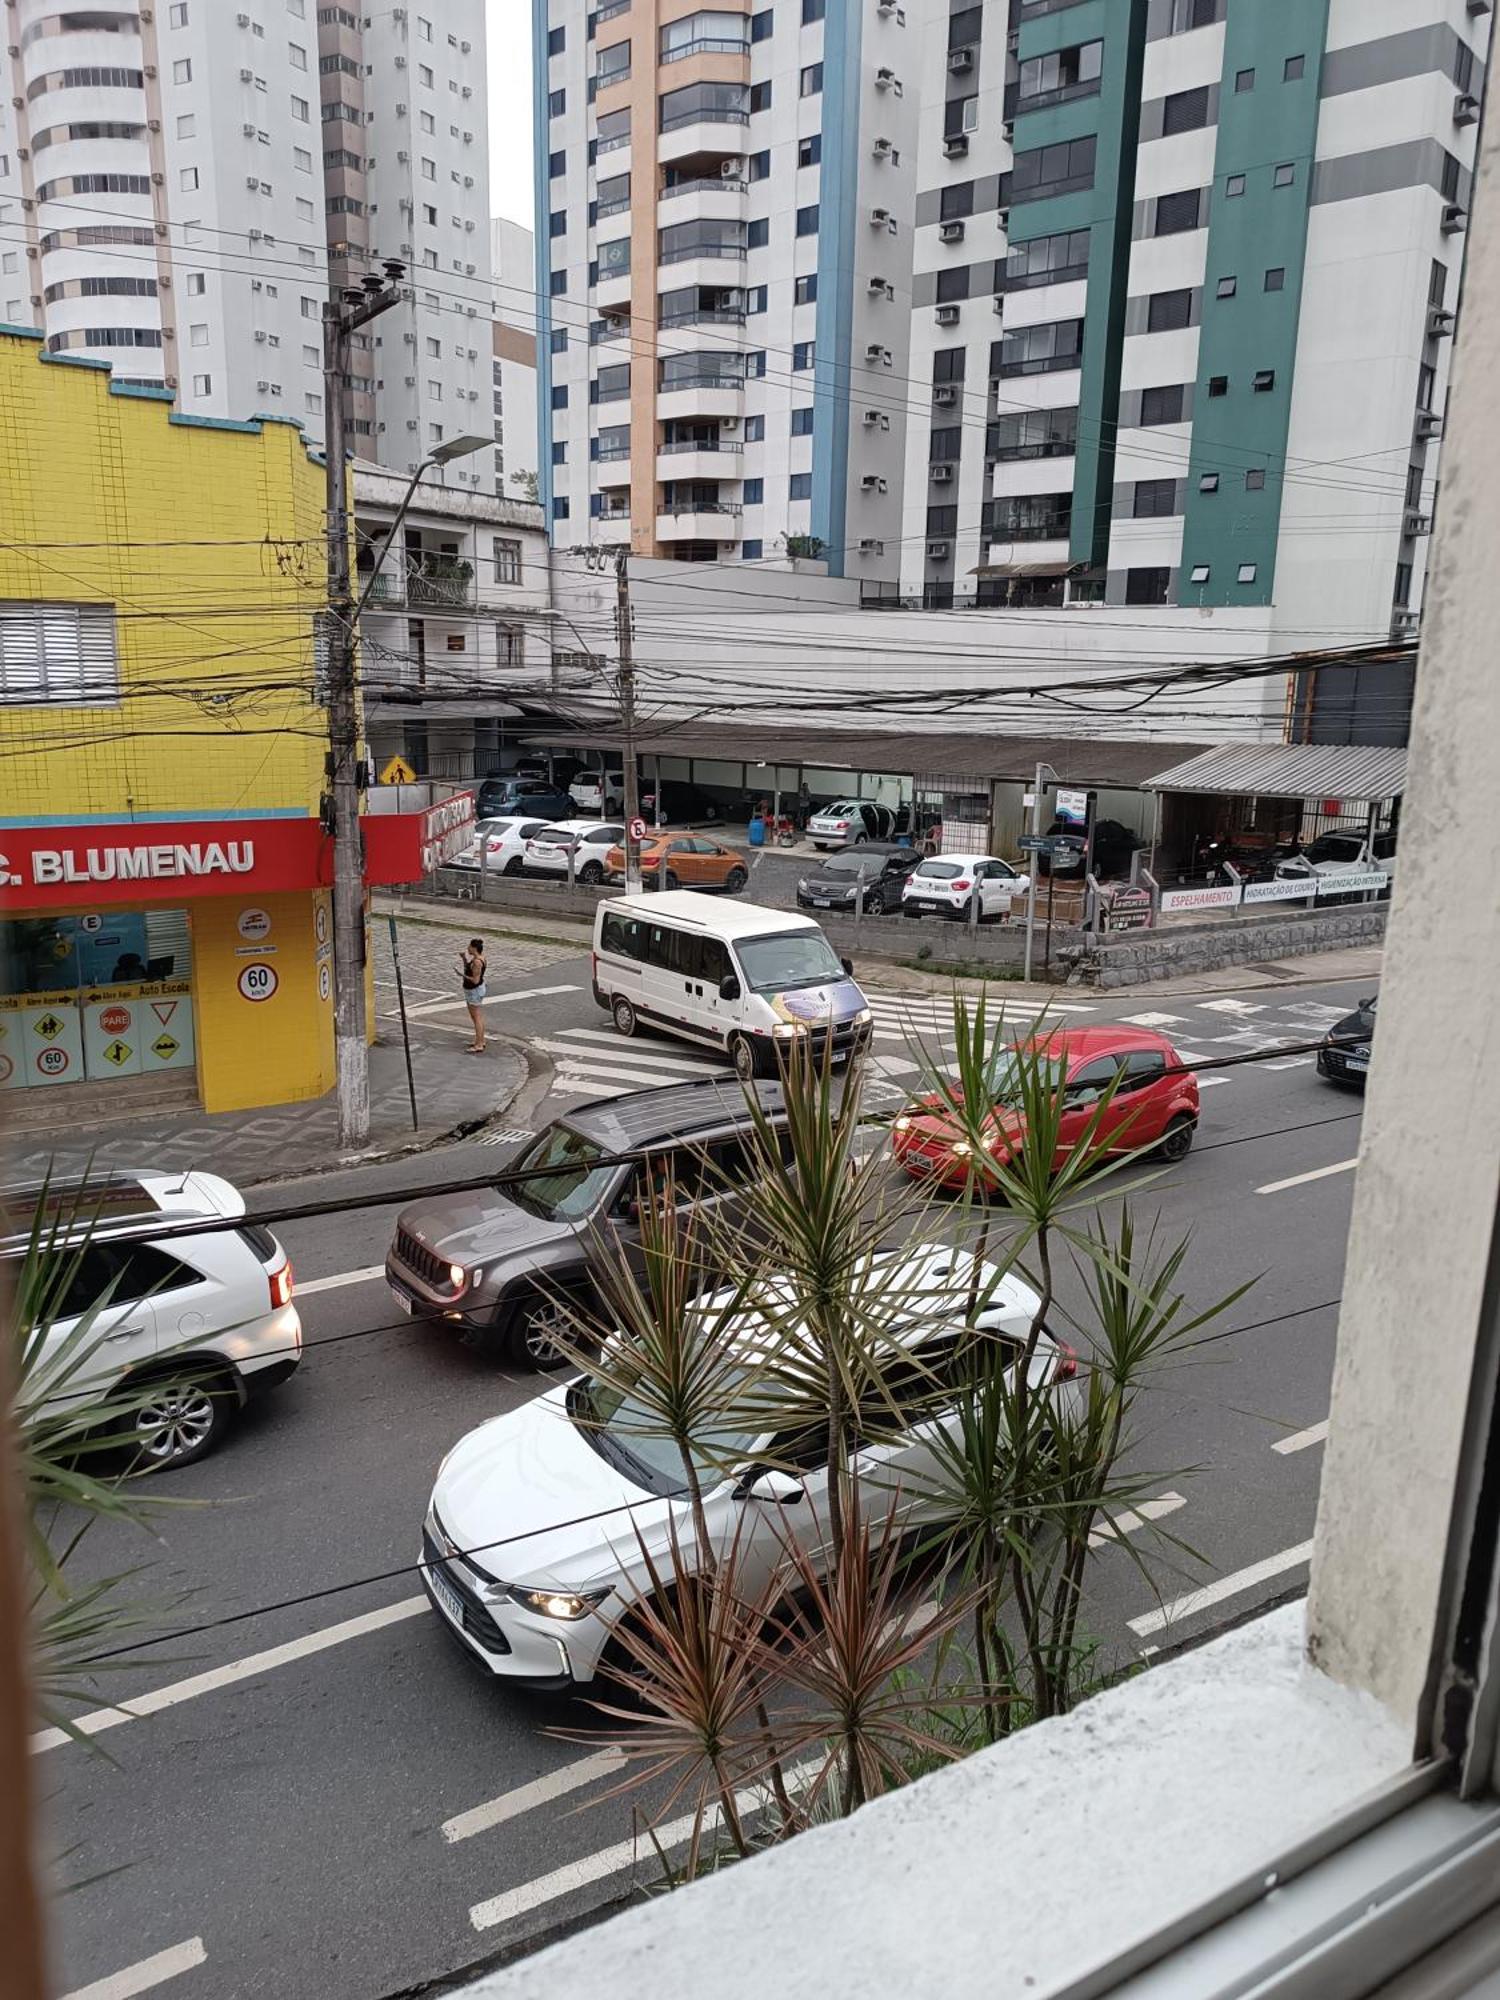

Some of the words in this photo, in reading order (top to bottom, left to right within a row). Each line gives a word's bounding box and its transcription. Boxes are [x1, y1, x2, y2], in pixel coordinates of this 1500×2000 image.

[32, 841, 254, 885] BLUMENAU
[1171, 891, 1233, 907] ESPELHAMENTO
[87, 917, 97, 929] E
[248, 969, 268, 988] 60
[139, 984, 159, 996] Auto
[161, 981, 190, 994] Escola
[103, 1014, 129, 1026] PARE
[45, 1052, 62, 1064] 60
